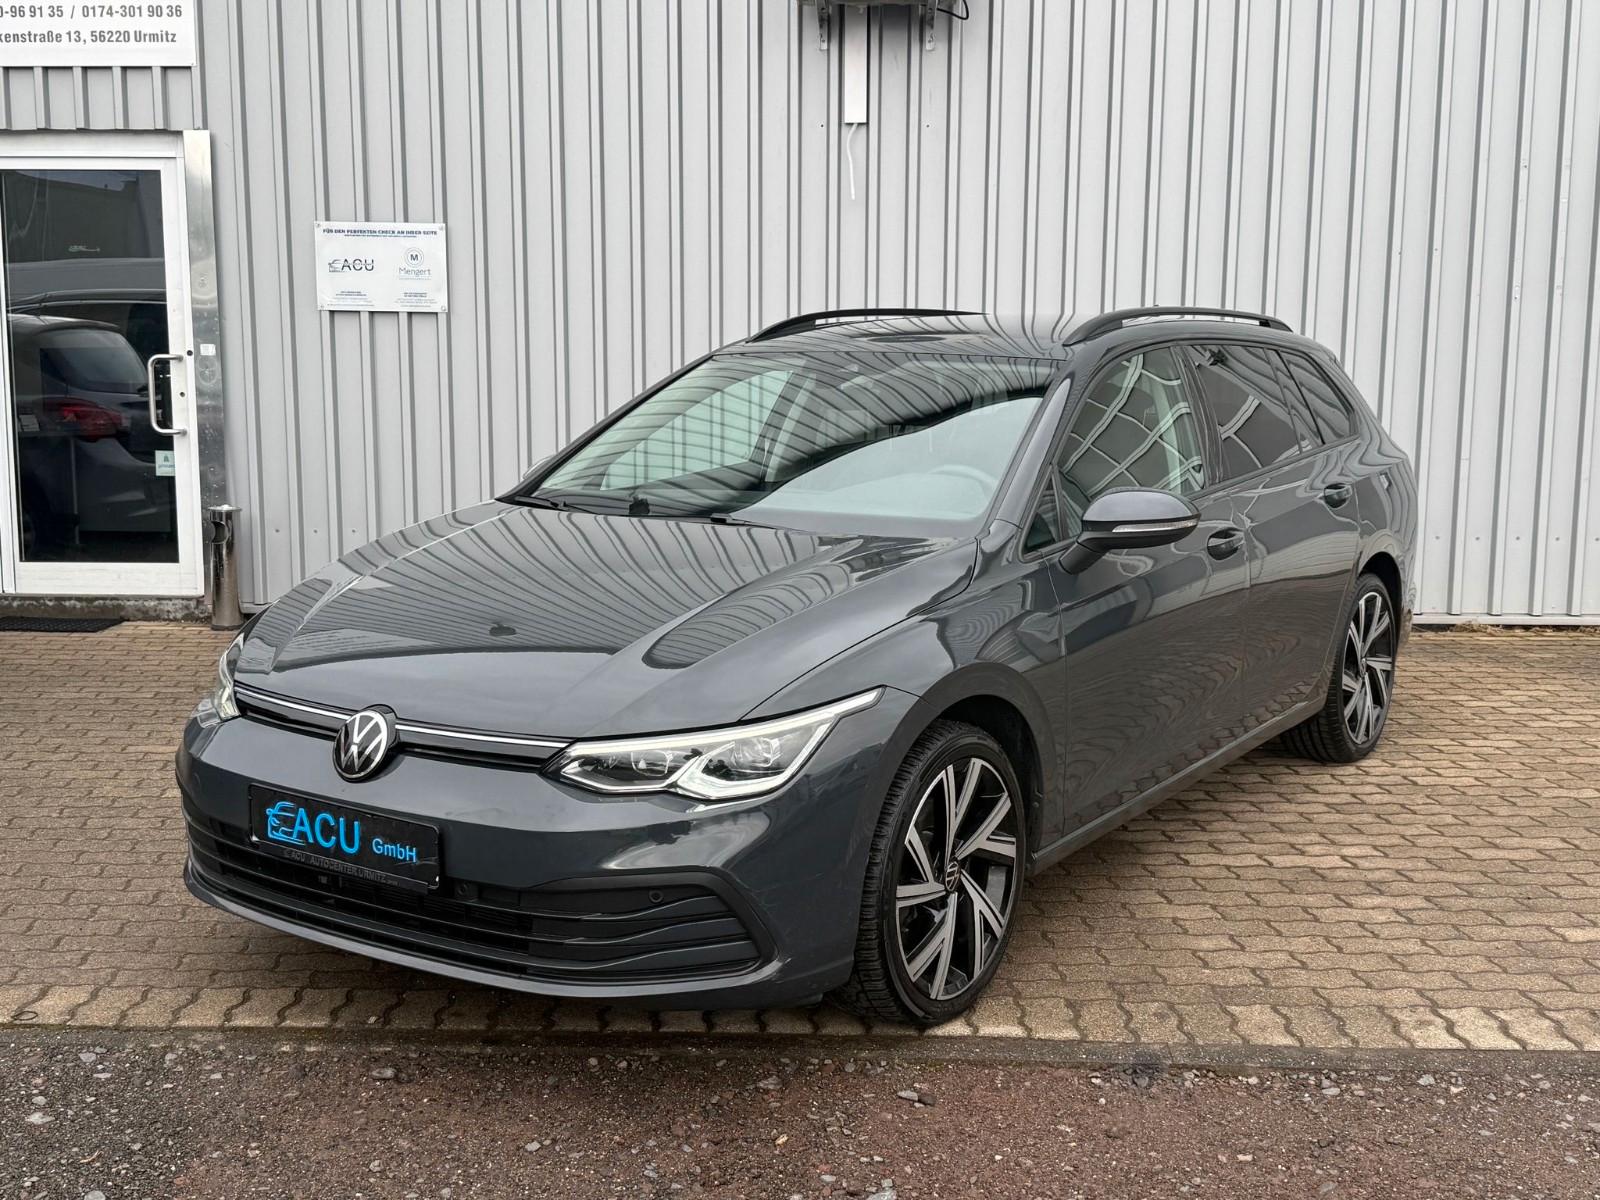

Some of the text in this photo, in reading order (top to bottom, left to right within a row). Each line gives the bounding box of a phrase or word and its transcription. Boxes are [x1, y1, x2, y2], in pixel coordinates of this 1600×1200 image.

[29, 5, 43, 18] 91
[48, 5, 64, 18] 35
[82, 5, 142, 18] 0174-301
[147, 5, 163, 18] 90
[166, 5, 183, 18] 36
[66, 30, 87, 45] 13,
[90, 30, 130, 43] 56220
[134, 30, 177, 43] Urmitz
[410, 253, 419, 261] M
[341, 259, 374, 271] ACU
[292, 807, 418, 864] ACU GmbH
[310, 856, 358, 876] AUTOCENTER
[358, 867, 387, 883] URMITZ
